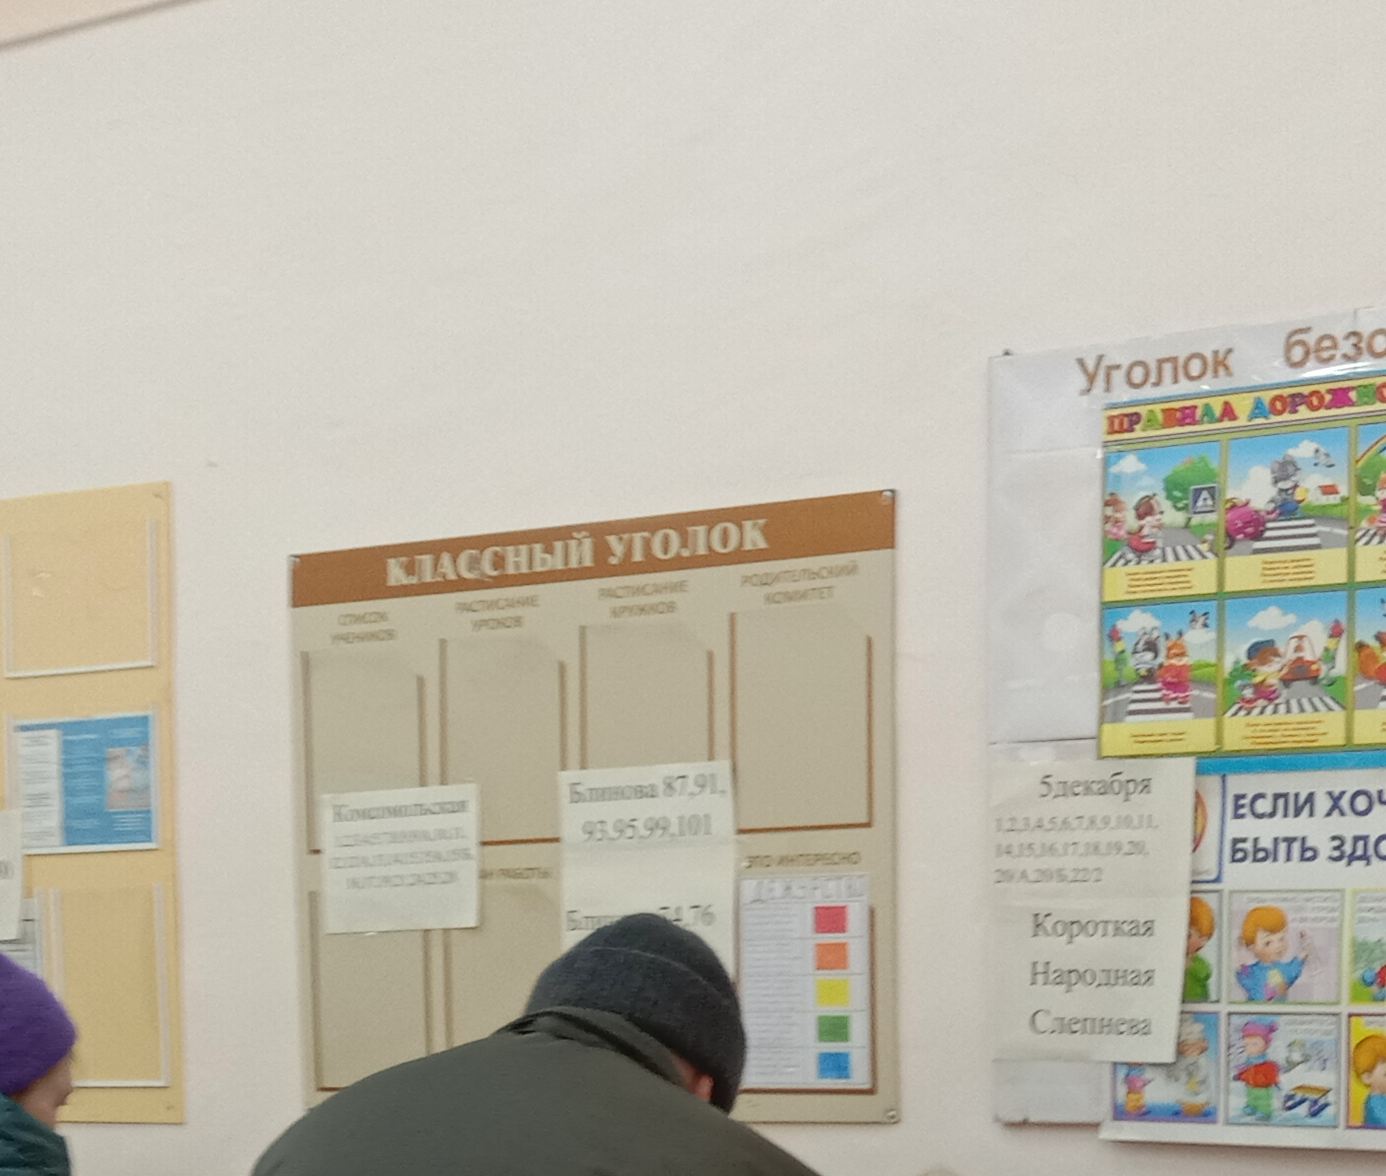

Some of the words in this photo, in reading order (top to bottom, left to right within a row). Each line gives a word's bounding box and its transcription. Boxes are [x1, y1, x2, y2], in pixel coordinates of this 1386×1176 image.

[1076, 348, 1234, 394] Уголок
[1107, 401, 1237, 434] ПРАВИЛА
[386, 532, 594, 587] КЛАССНЫЙ
[606, 519, 769, 564] УГОЛОК
[568, 782, 658, 804] Блинова
[1039, 771, 1152, 802] 5декабря
[1232, 791, 1315, 820] ЕСЛИ
[1230, 836, 1318, 863] БЫТЬ
[1031, 913, 1155, 942] Короткая
[1030, 961, 1155, 990] Народная
[1031, 1009, 1152, 1039] Слепнева
